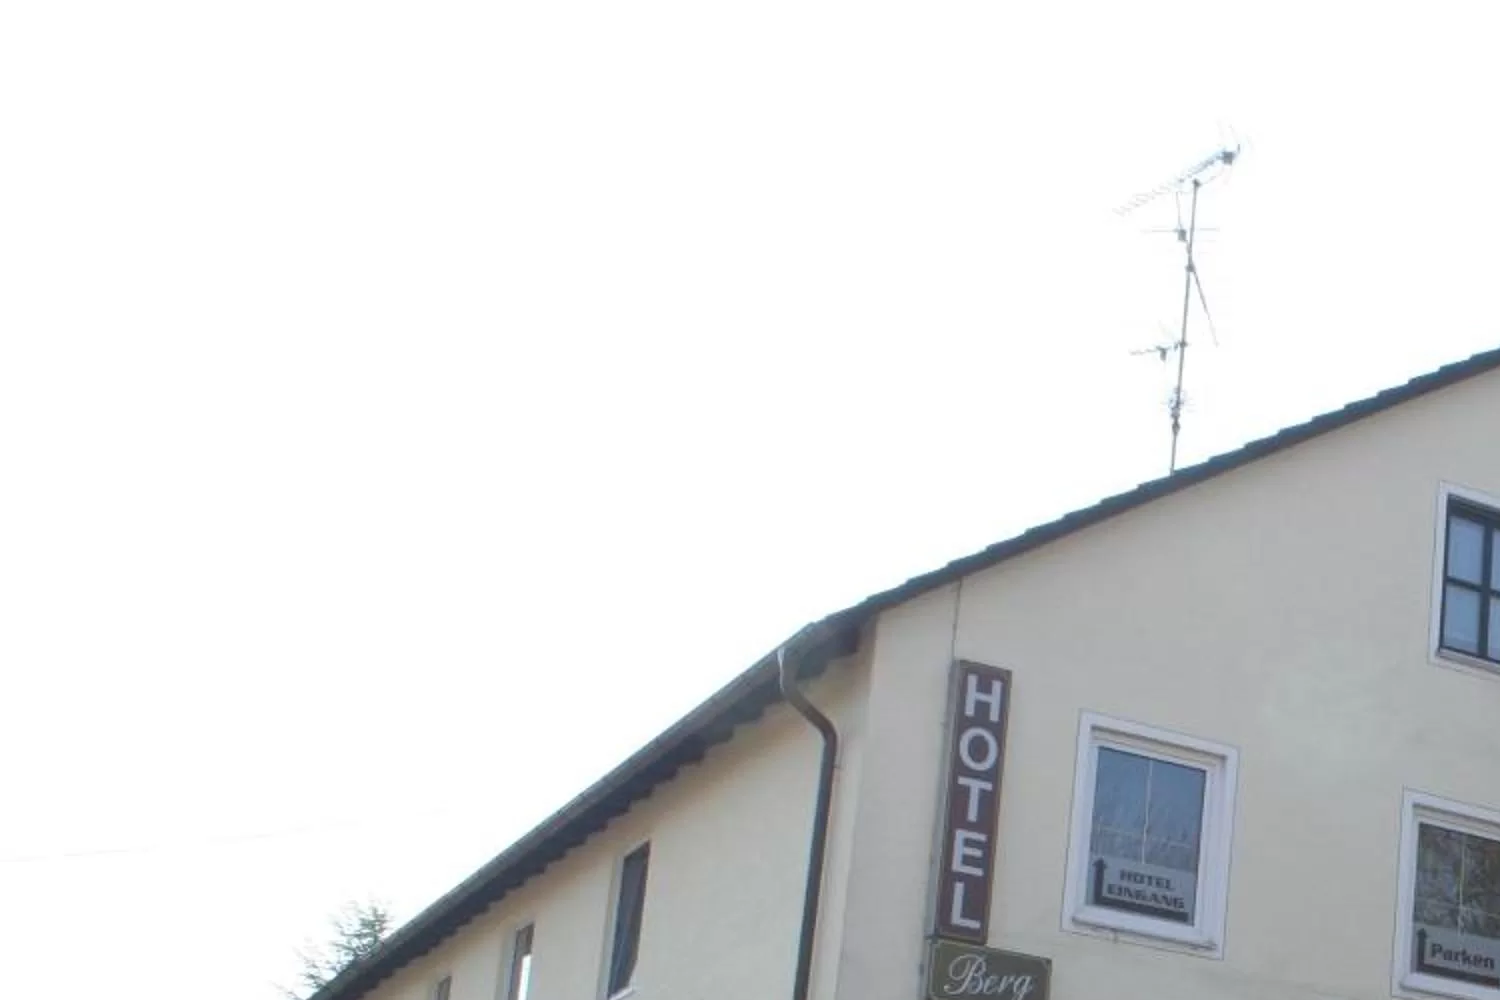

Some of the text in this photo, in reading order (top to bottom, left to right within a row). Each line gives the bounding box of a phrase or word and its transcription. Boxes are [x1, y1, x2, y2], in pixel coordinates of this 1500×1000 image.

[950, 673, 1004, 929] HOTEL
[1119, 868, 1175, 892] HOTEL
[1431, 943, 1496, 970] Parken
